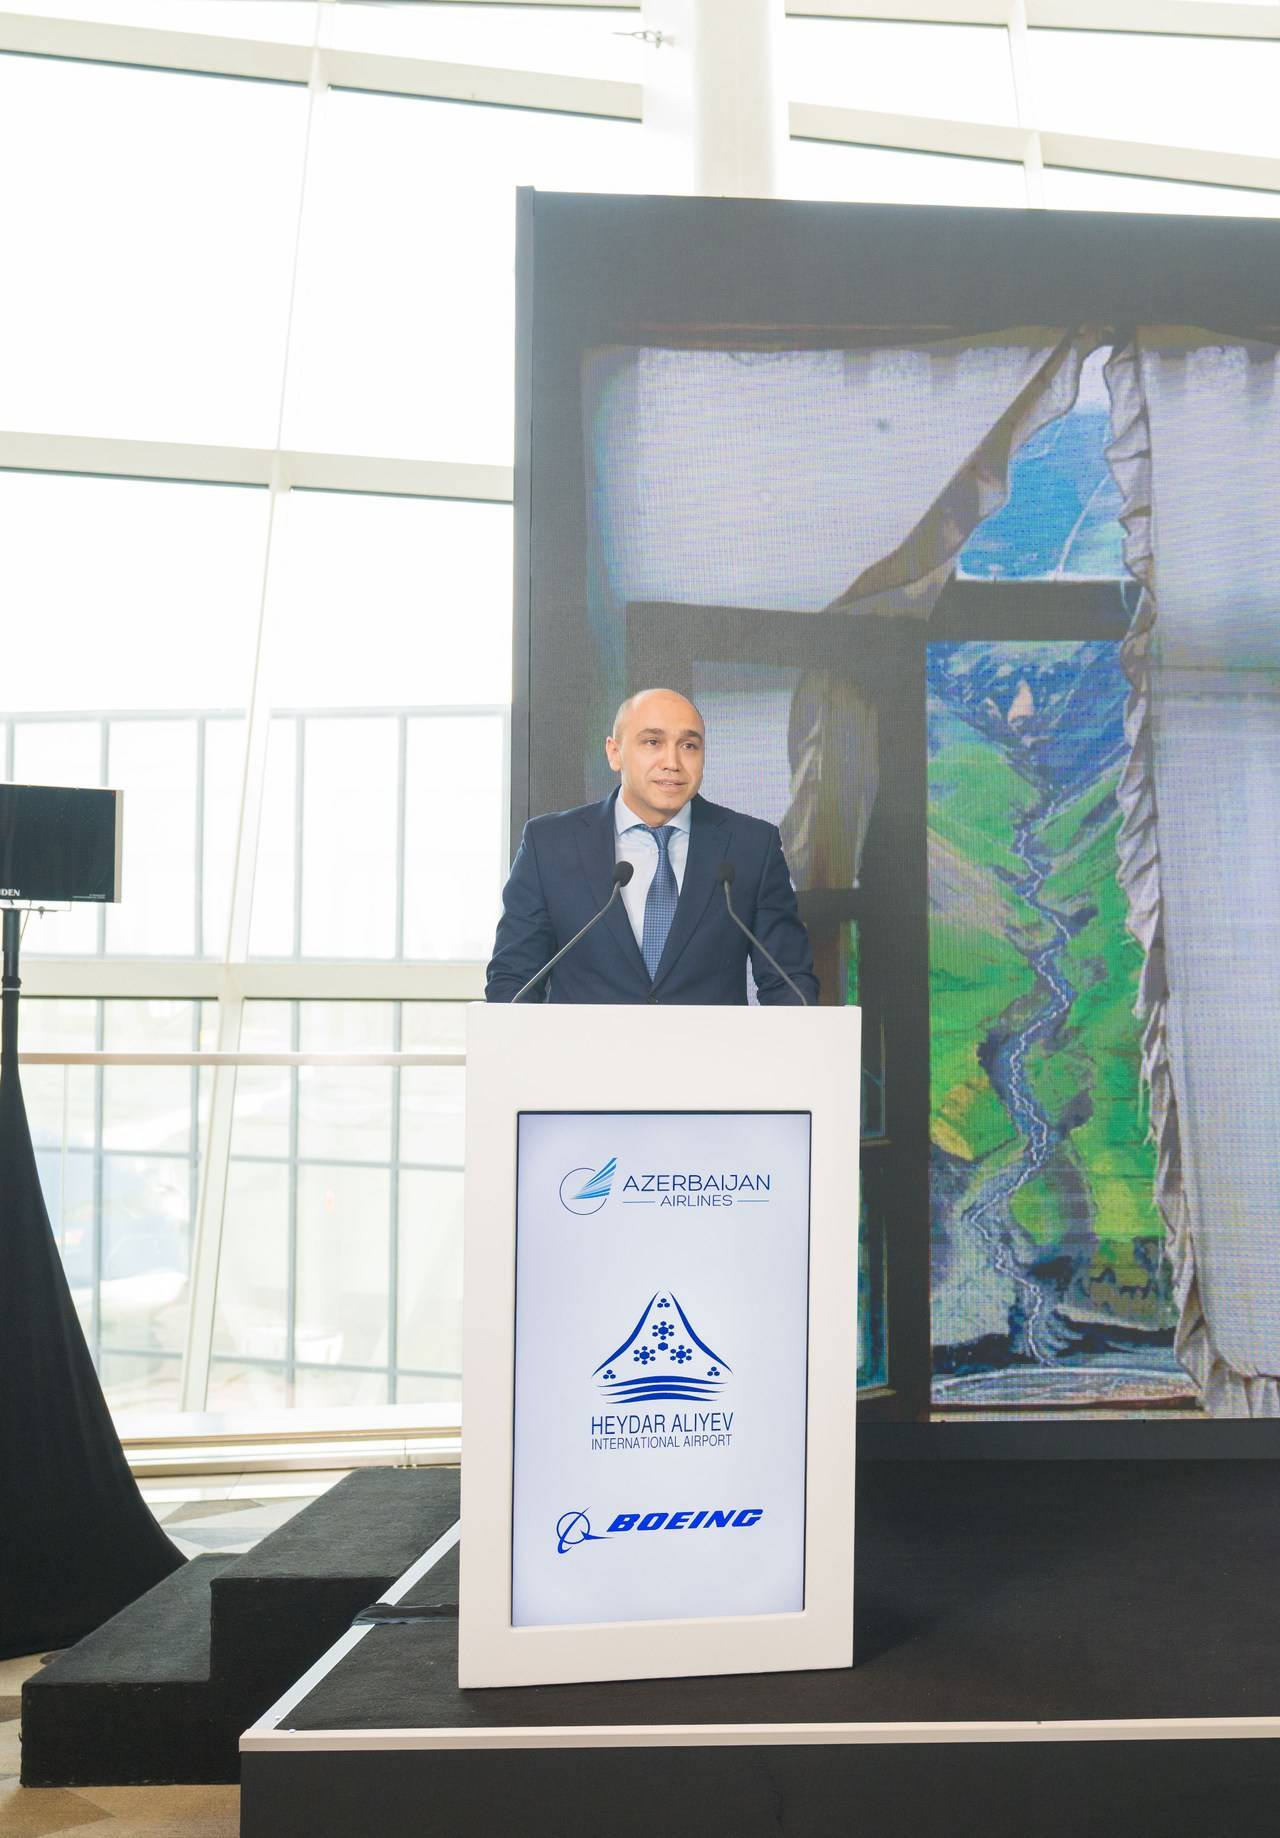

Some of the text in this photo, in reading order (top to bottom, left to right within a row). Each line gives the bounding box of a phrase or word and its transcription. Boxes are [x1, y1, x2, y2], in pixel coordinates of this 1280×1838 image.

[622, 1173, 771, 1193] AZERBAIJAN
[660, 1193, 734, 1208] AIRLINES
[591, 1412, 734, 1435] HEYDAR ALIYEV
[591, 1434, 733, 1450] INTERNATIONAL AIRPORT
[606, 1508, 764, 1533] BOEING
